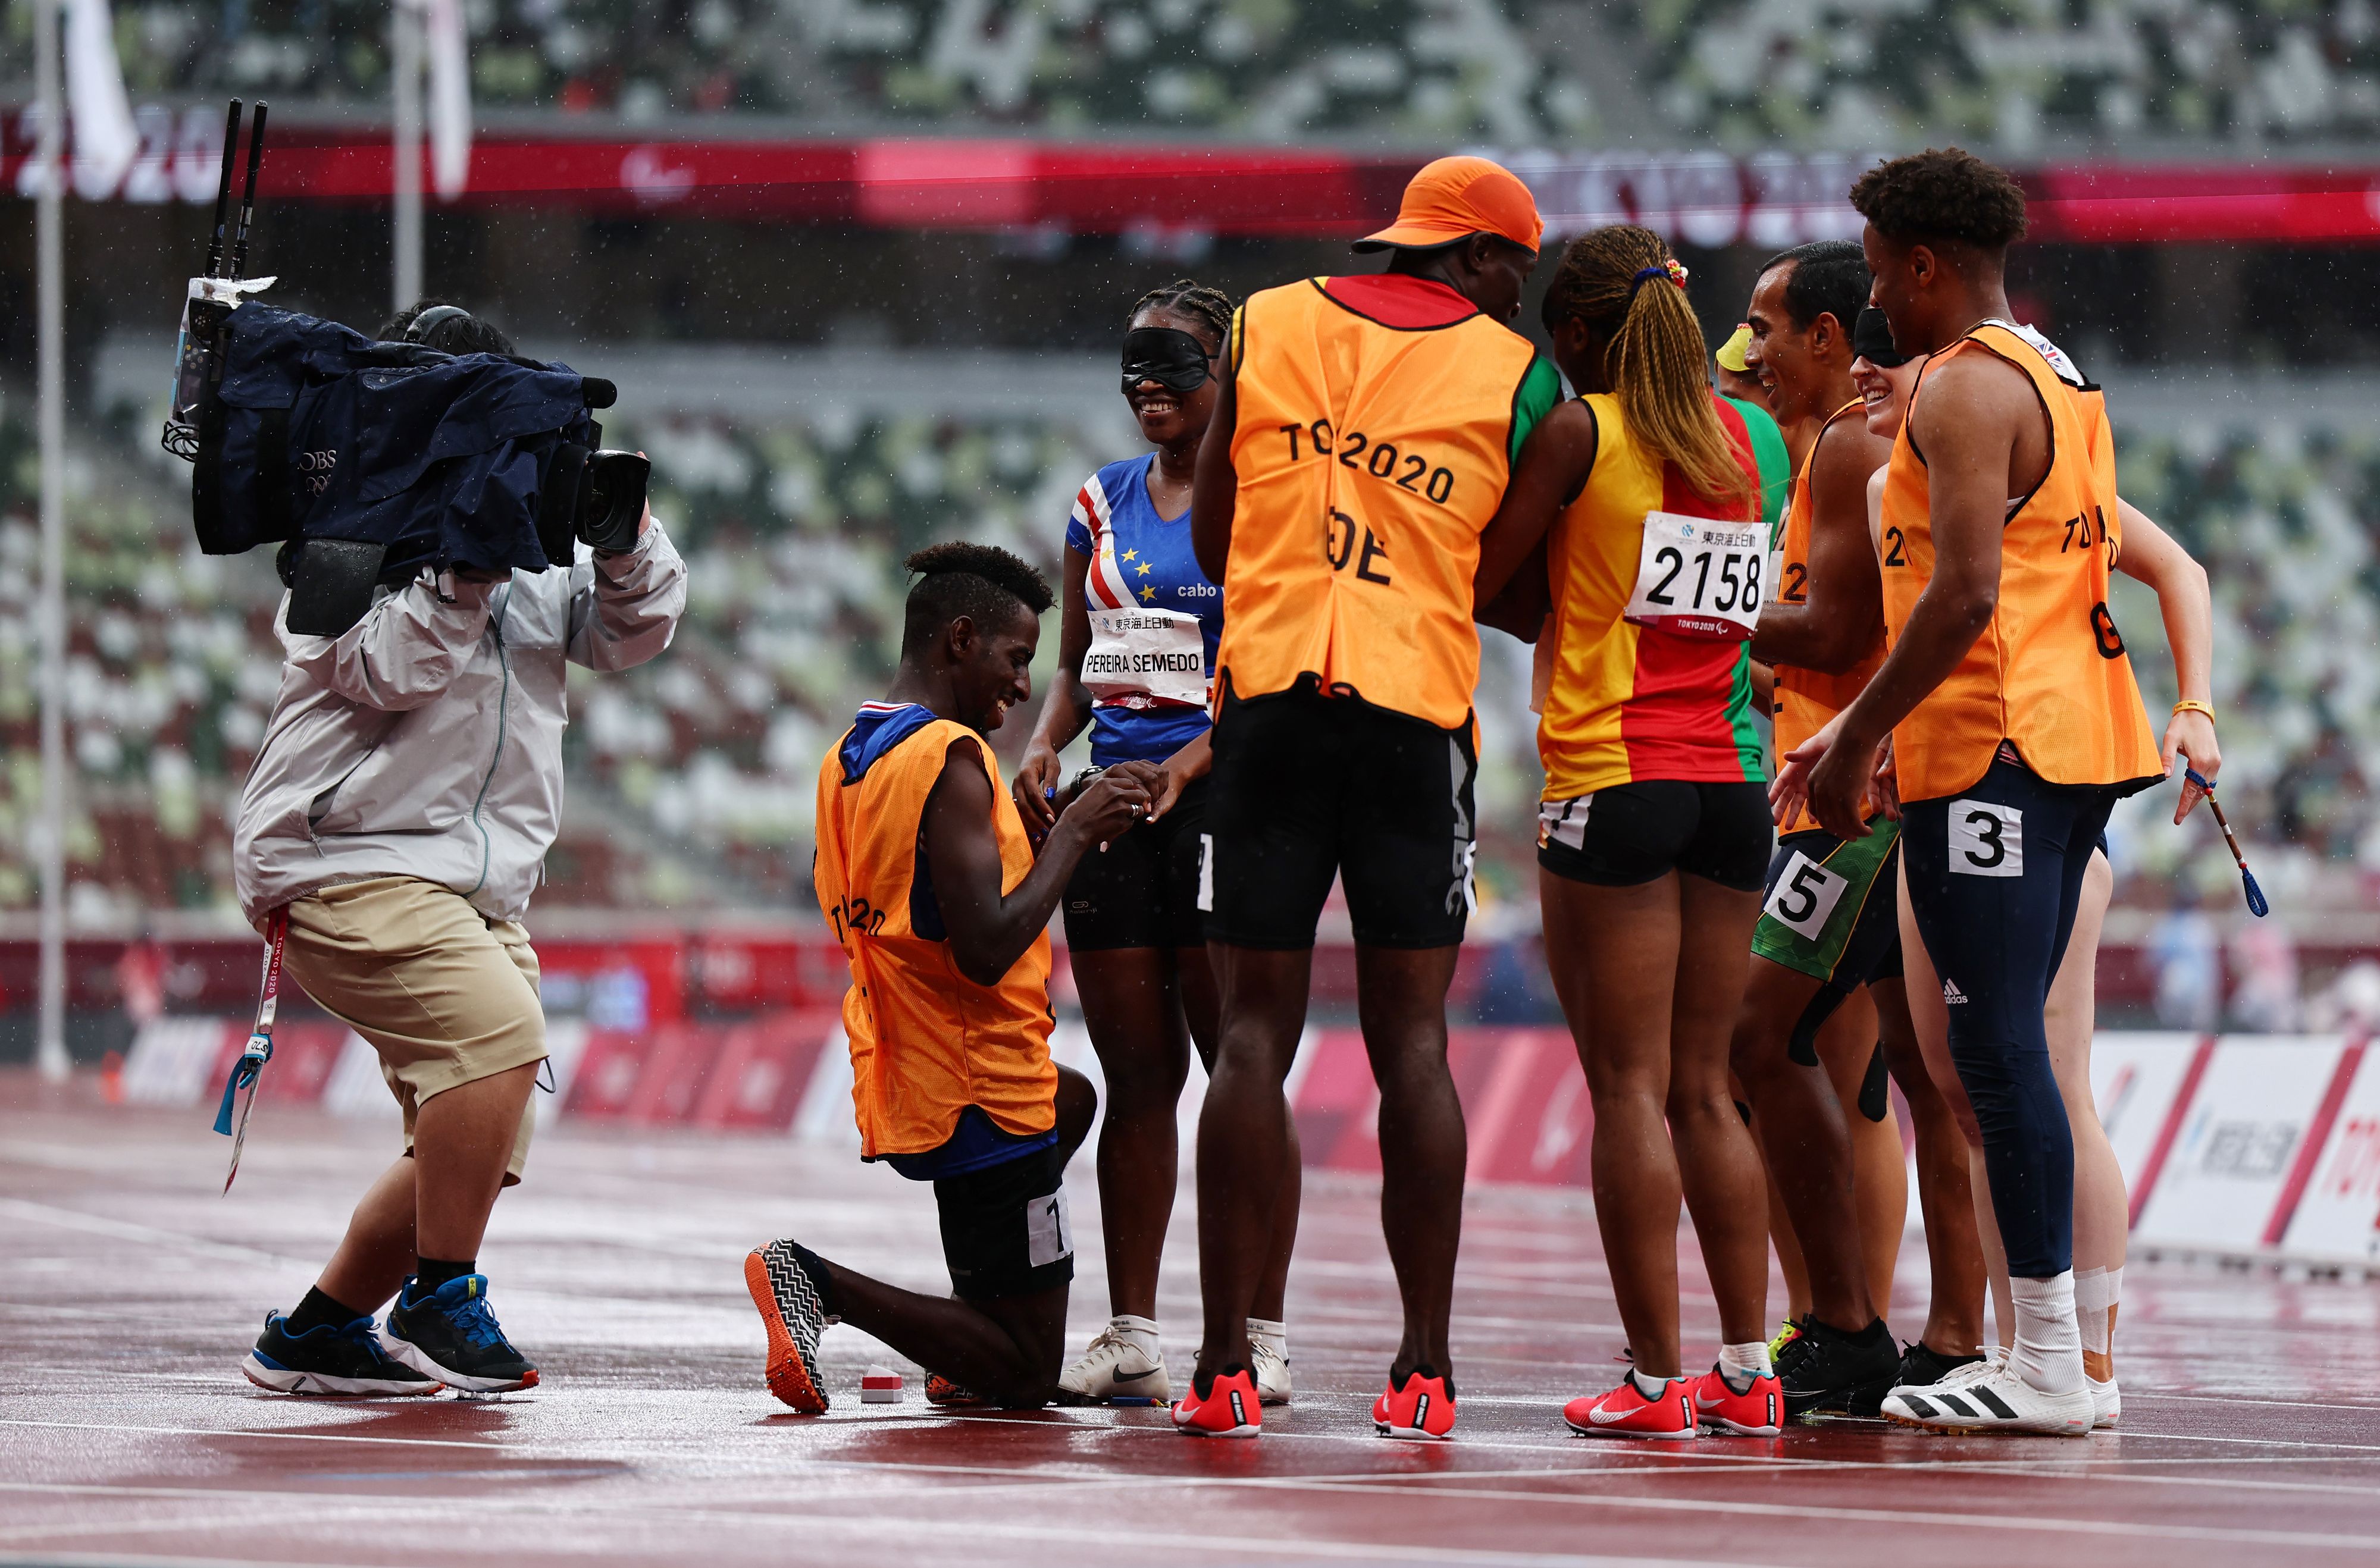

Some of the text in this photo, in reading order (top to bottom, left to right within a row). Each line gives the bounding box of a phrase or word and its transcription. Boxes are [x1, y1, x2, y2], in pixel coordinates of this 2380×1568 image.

[299, 450, 336, 471] OBS
[1339, 432, 1454, 504] 2020
[1701, 531, 1756, 547] 東京海上日動
[1178, 582, 1216, 597] cabo
[1646, 547, 1760, 612] 2158
[1115, 617, 1175, 631] 東京海上日動
[1678, 619, 1715, 632] TOKYO 2020
[1086, 653, 1199, 673] PEREIRA SEMEDO
[1965, 811, 2005, 868] 3
[1778, 863, 1827, 923] 5
[268, 936, 283, 993] TOKYO 2020
[1944, 994, 1968, 1004] didas
[1046, 1197, 1064, 1253] 1
